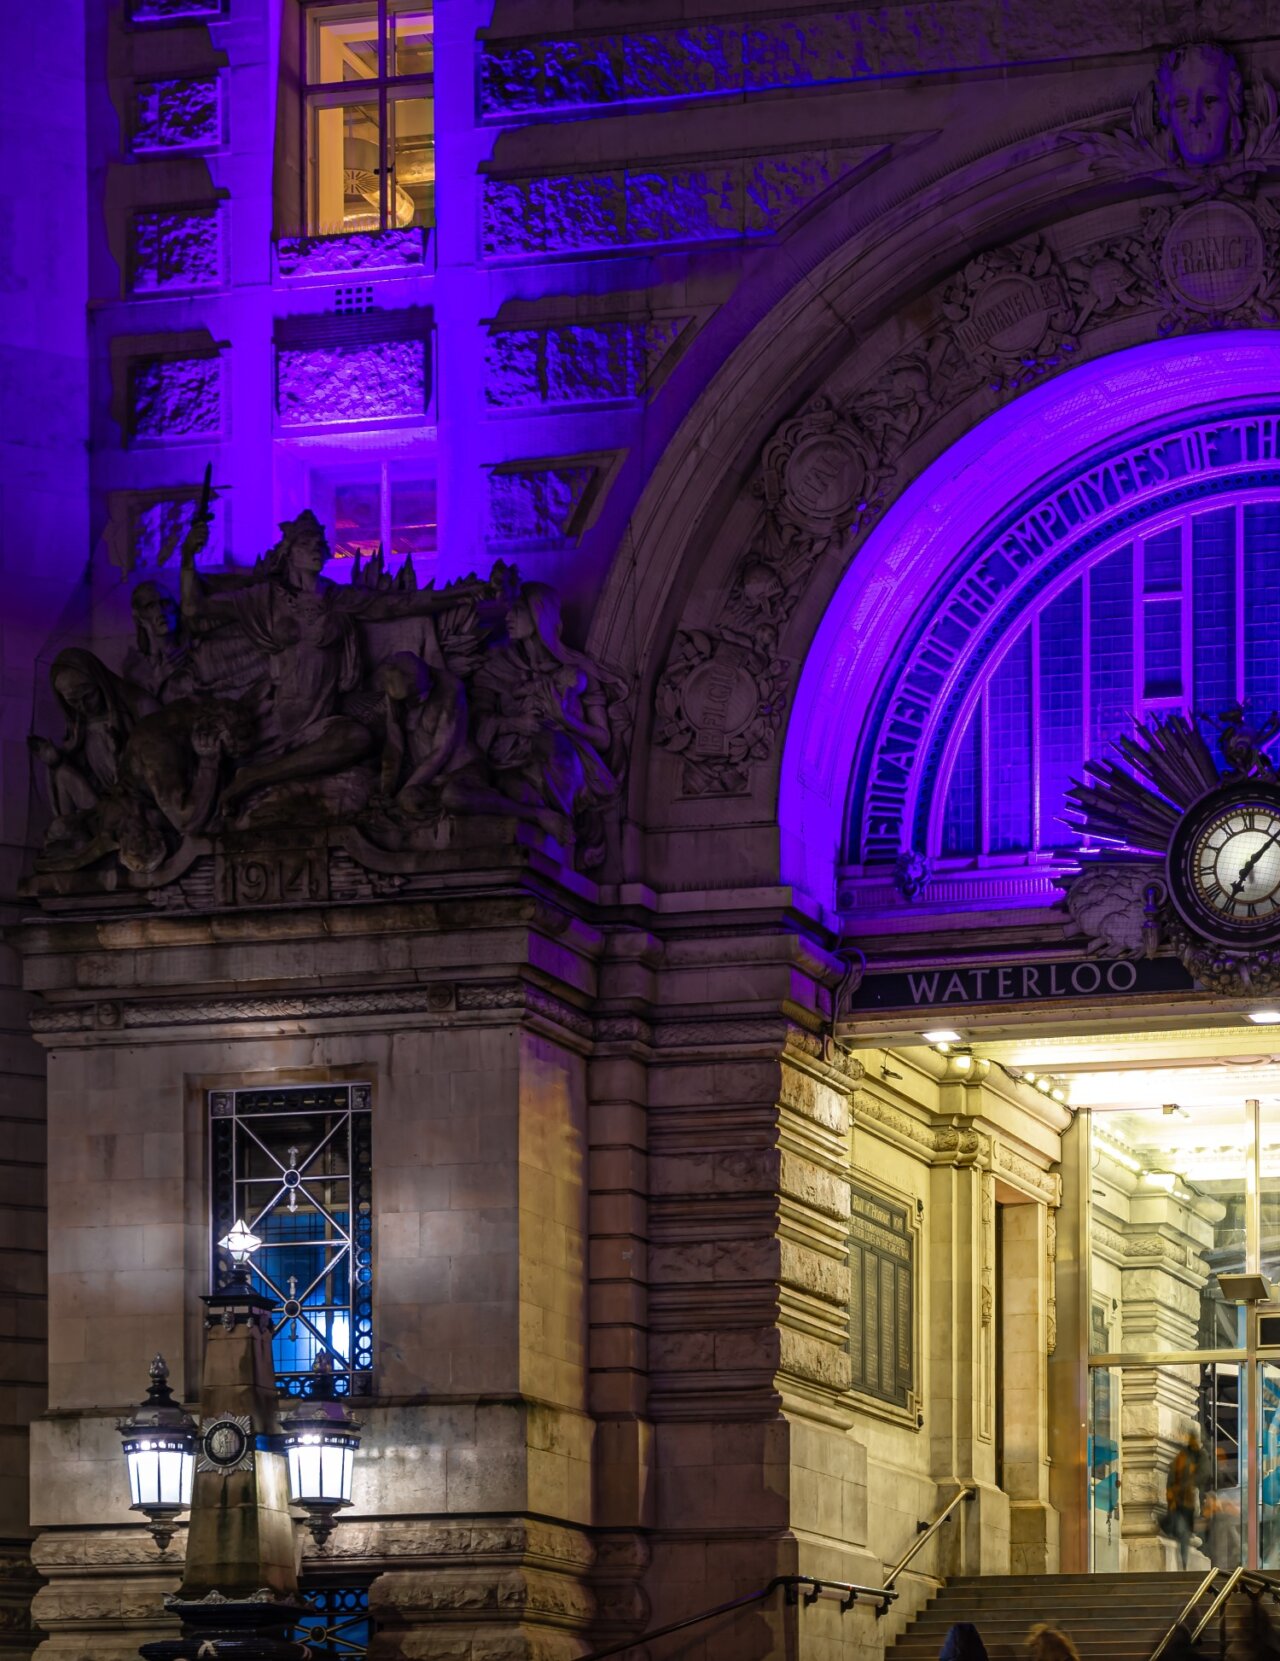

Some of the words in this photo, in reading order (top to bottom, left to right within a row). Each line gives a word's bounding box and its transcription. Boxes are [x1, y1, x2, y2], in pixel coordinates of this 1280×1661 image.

[1169, 236, 1258, 279] FRANCE
[863, 683, 938, 862] DEDICATED
[912, 635, 960, 676] TO
[941, 565, 1005, 633] THE
[999, 444, 1170, 576] EMPLOYEES
[1182, 428, 1217, 472] OF
[698, 655, 738, 746] BELGIU
[222, 857, 316, 906] 1914
[907, 960, 1137, 1004] WATERLOO
